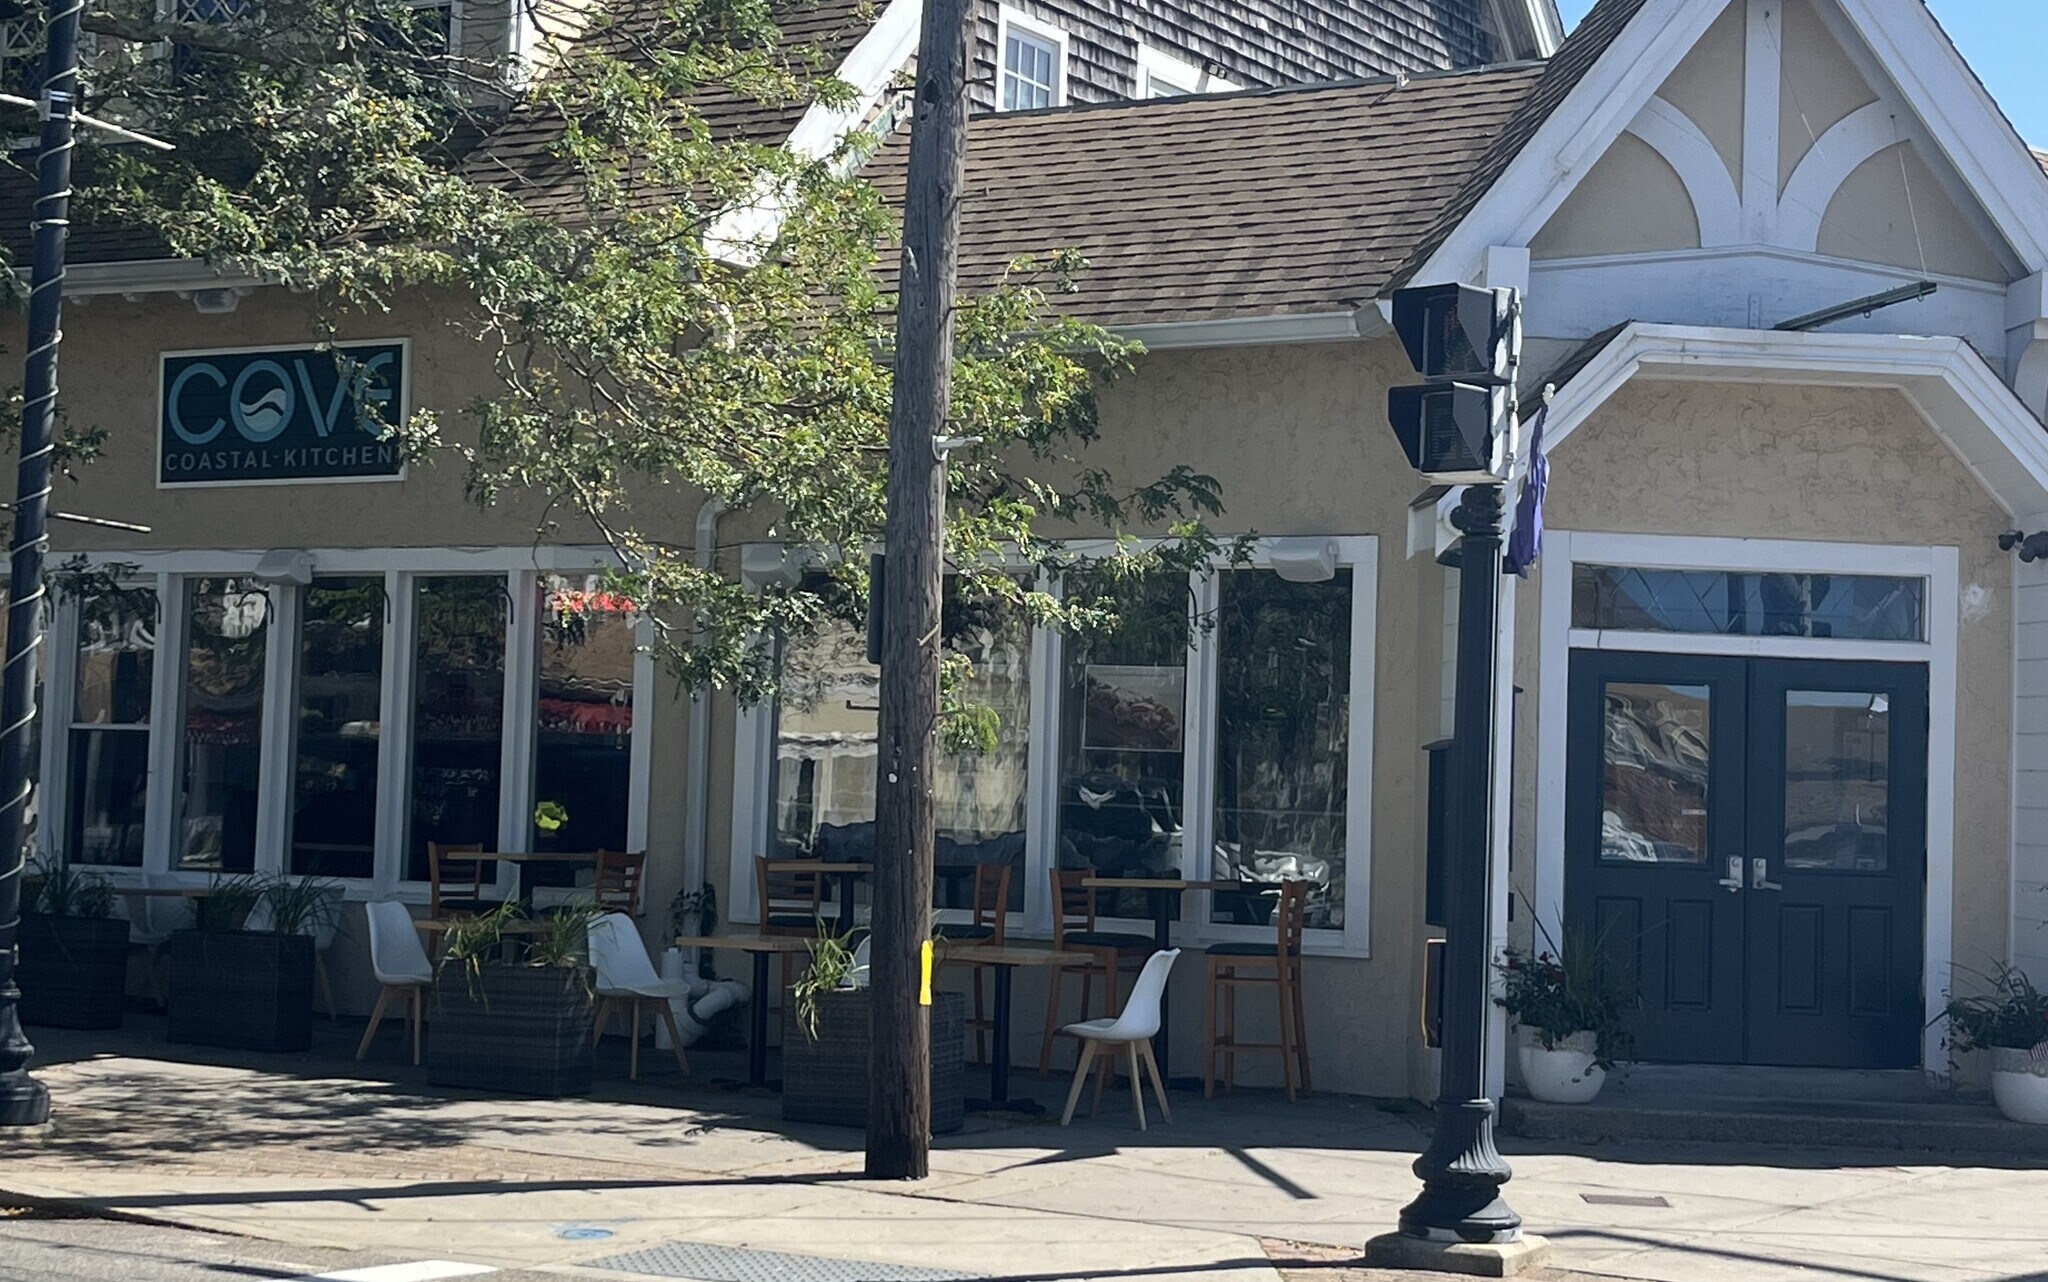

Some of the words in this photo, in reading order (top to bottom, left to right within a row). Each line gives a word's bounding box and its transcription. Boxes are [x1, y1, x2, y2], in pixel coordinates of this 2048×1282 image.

[168, 352, 393, 444] COVE
[165, 450, 273, 472] COASTAL
[283, 446, 393, 468] KITCHEN
